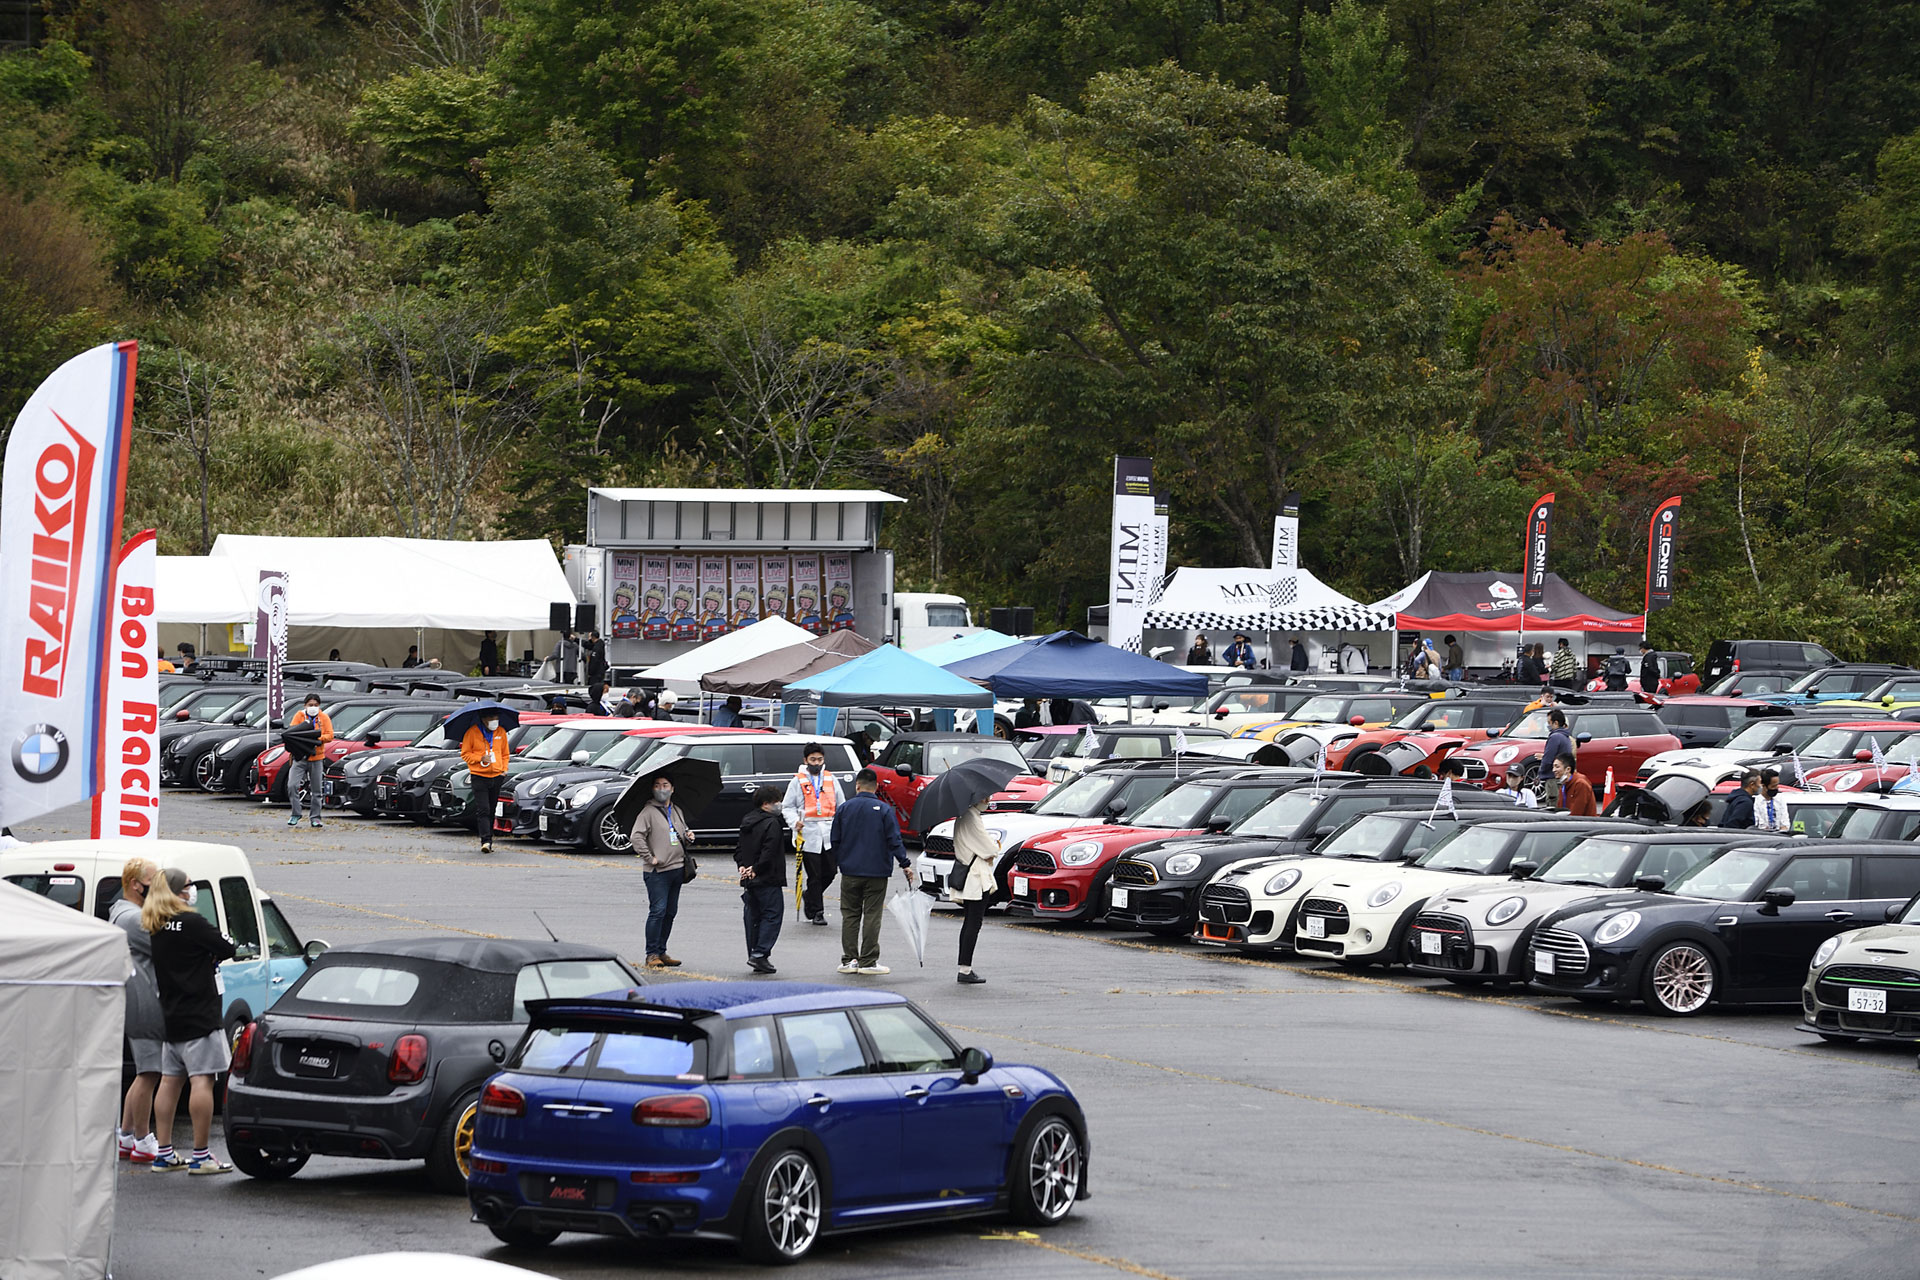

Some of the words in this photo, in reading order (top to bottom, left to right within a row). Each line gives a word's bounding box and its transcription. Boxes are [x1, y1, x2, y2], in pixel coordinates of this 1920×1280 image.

[617, 559, 635, 567] MINI
[647, 560, 665, 569] MINI
[675, 562, 693, 570] MINI
[705, 562, 723, 570] MINI
[736, 562, 754, 570] MINI
[798, 560, 816, 568] MINI
[22, 442, 77, 698] RAIKO
[1217, 583, 1272, 598] MIN
[120, 584, 155, 679] Bon
[119, 700, 159, 838] Racin
[160, 920, 183, 932] OLE
[1856, 998, 1884, 1012] 57-32
